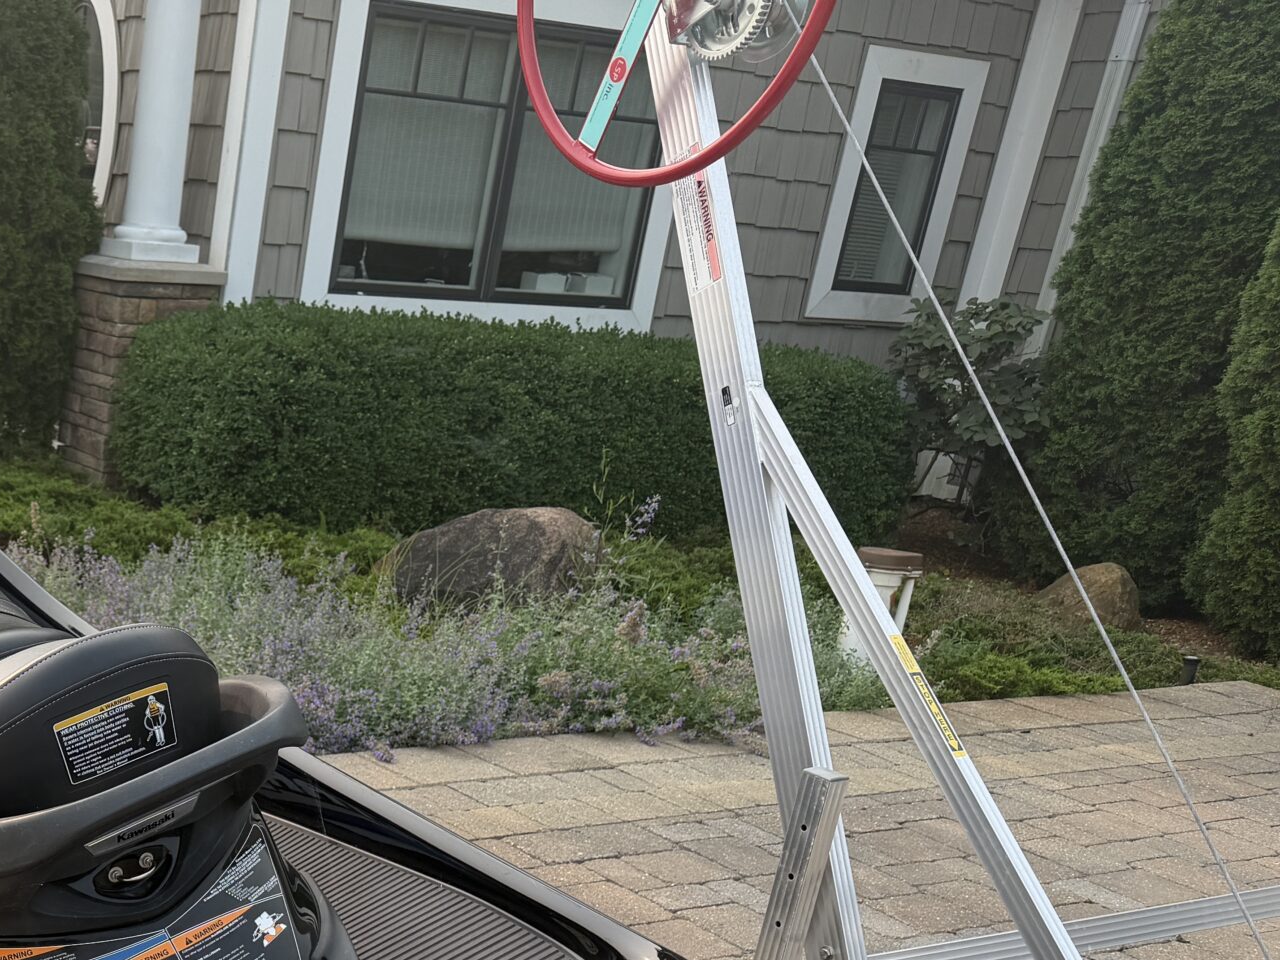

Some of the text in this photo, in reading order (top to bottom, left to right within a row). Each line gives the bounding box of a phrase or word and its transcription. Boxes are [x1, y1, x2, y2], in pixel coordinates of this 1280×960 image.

[612, 59, 625, 81] LSP
[698, 187, 715, 242] WARNING
[105, 696, 131, 710] WARNING
[914, 676, 955, 742] STOP HERE
[60, 726, 77, 736] WEAR
[77, 711, 109, 729] PROTECTIVE
[116, 811, 175, 843] Kawasaki
[192, 919, 224, 941] WARNING
